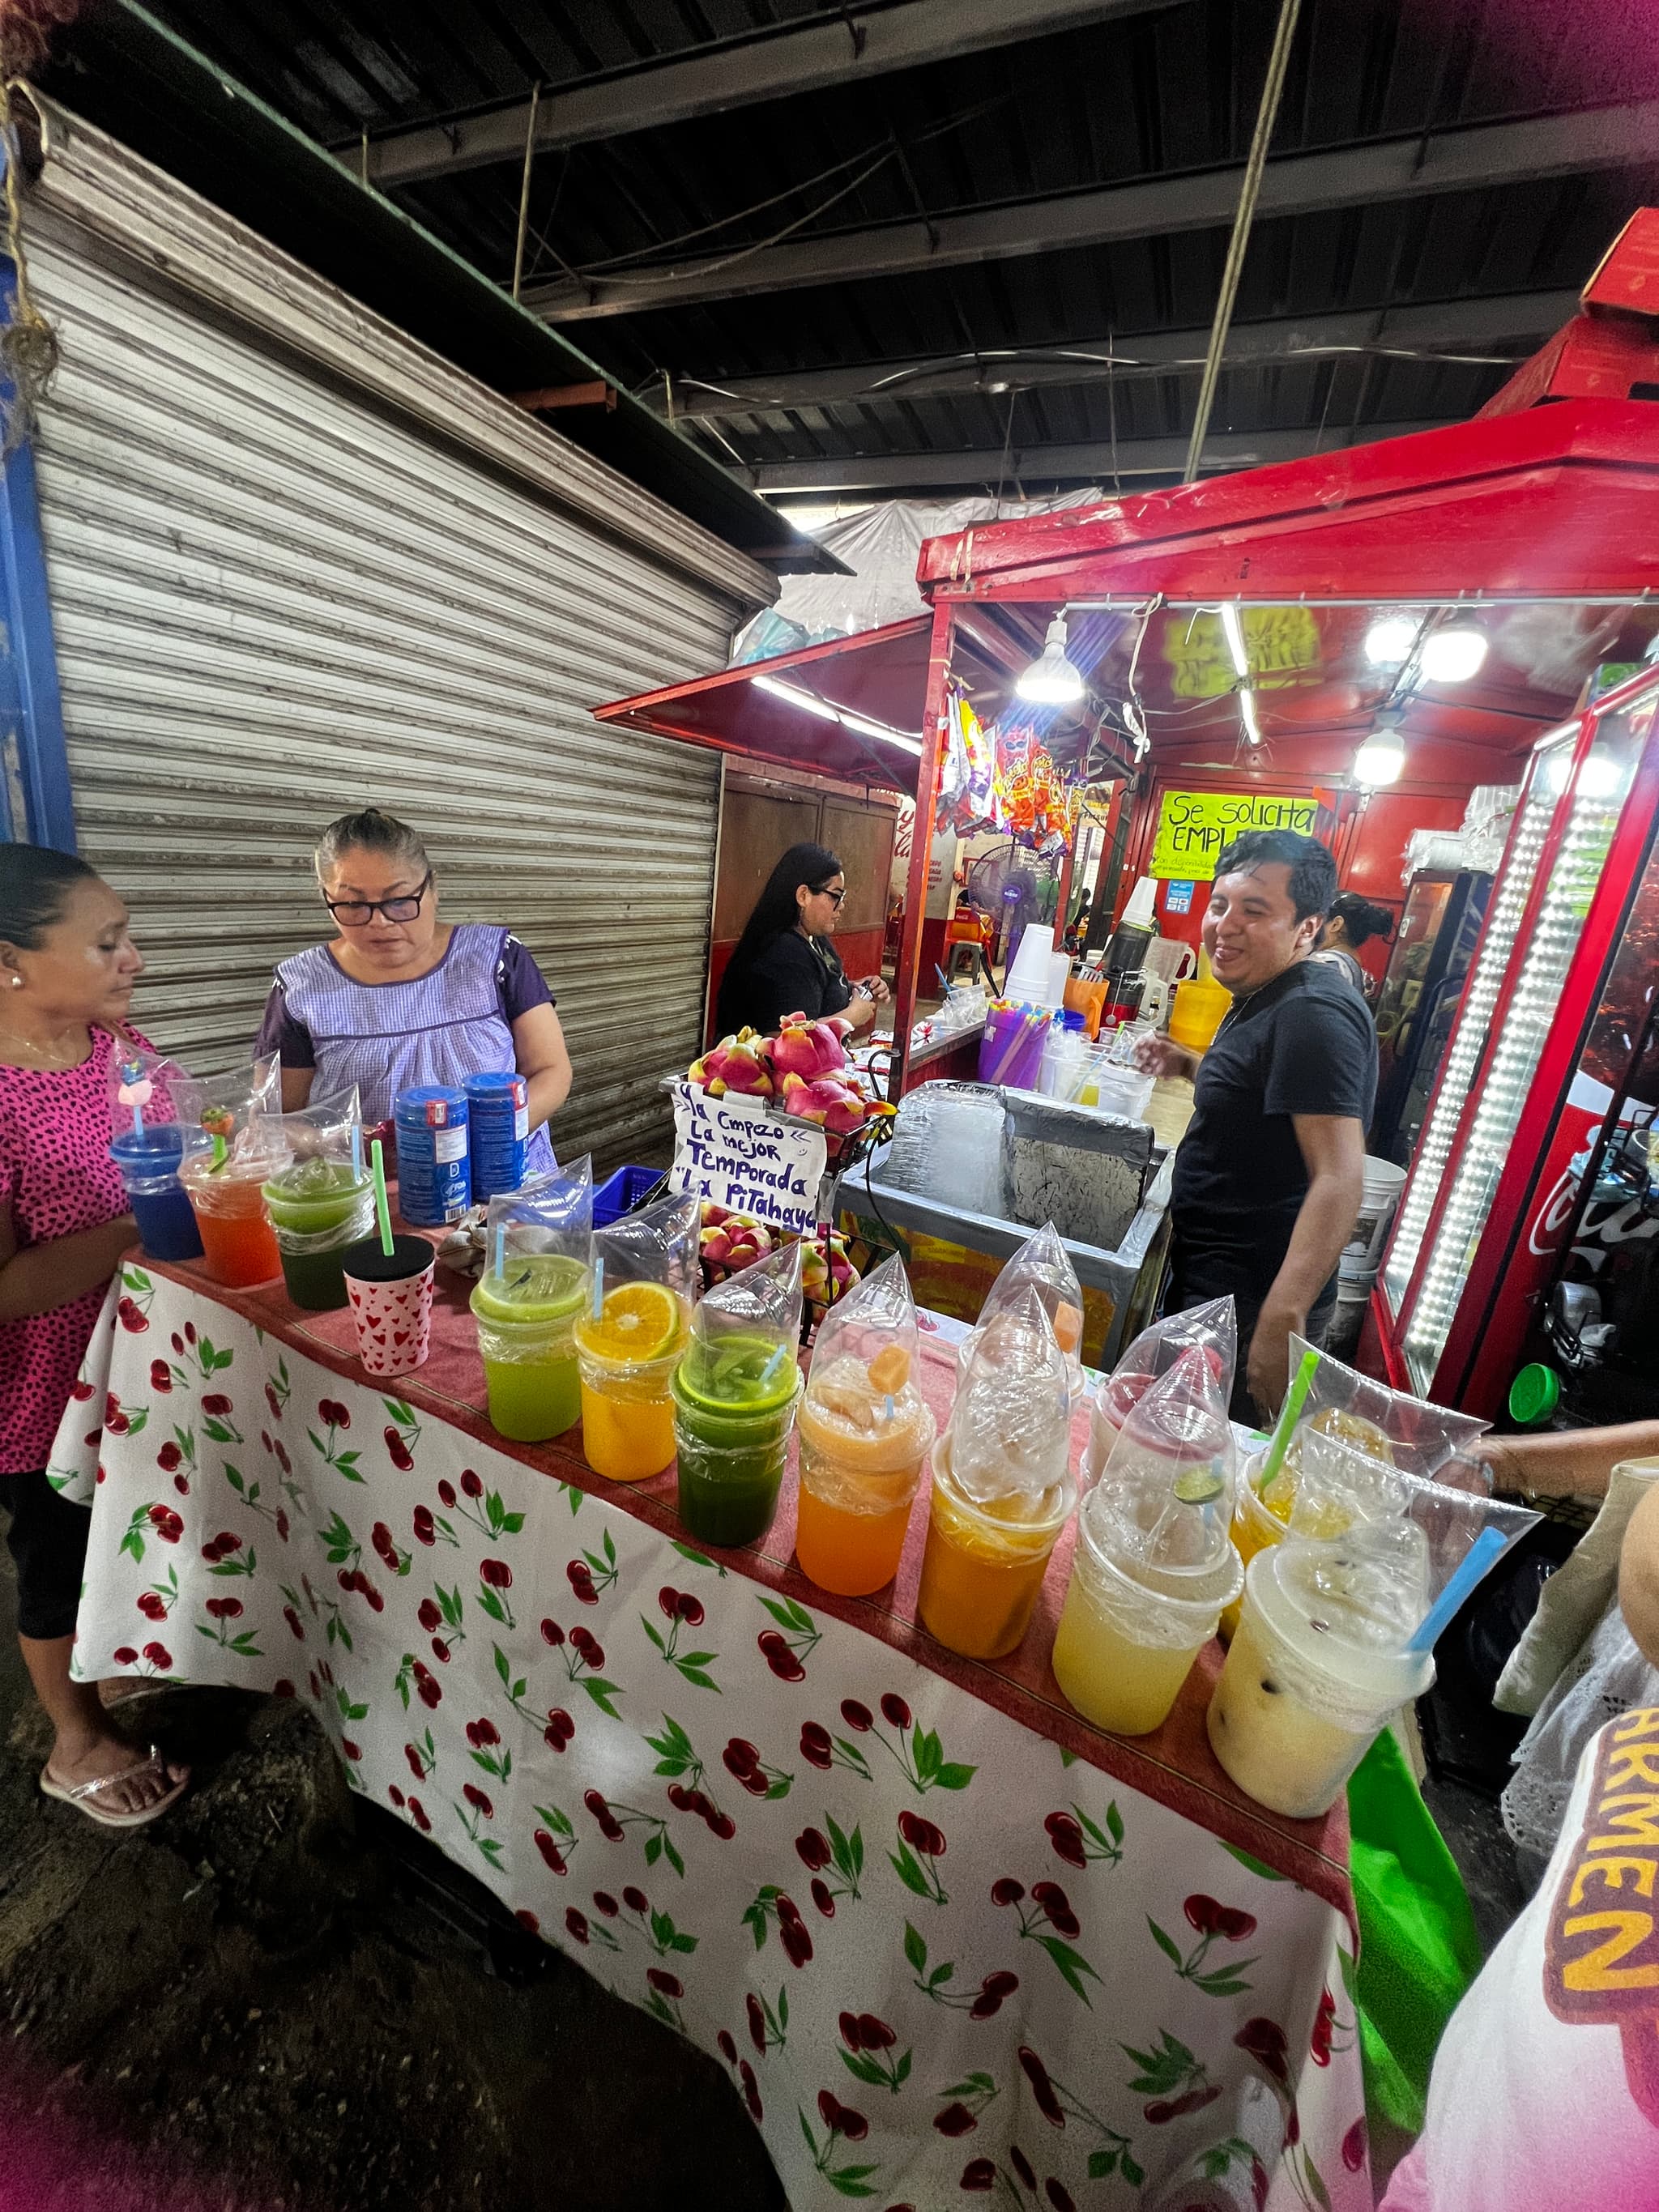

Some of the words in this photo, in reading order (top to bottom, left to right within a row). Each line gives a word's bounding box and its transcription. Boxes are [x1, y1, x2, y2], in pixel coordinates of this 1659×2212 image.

[1169, 795, 1204, 825] Se
[691, 1120, 715, 1142] La
[686, 1138, 808, 1197] Temporada
